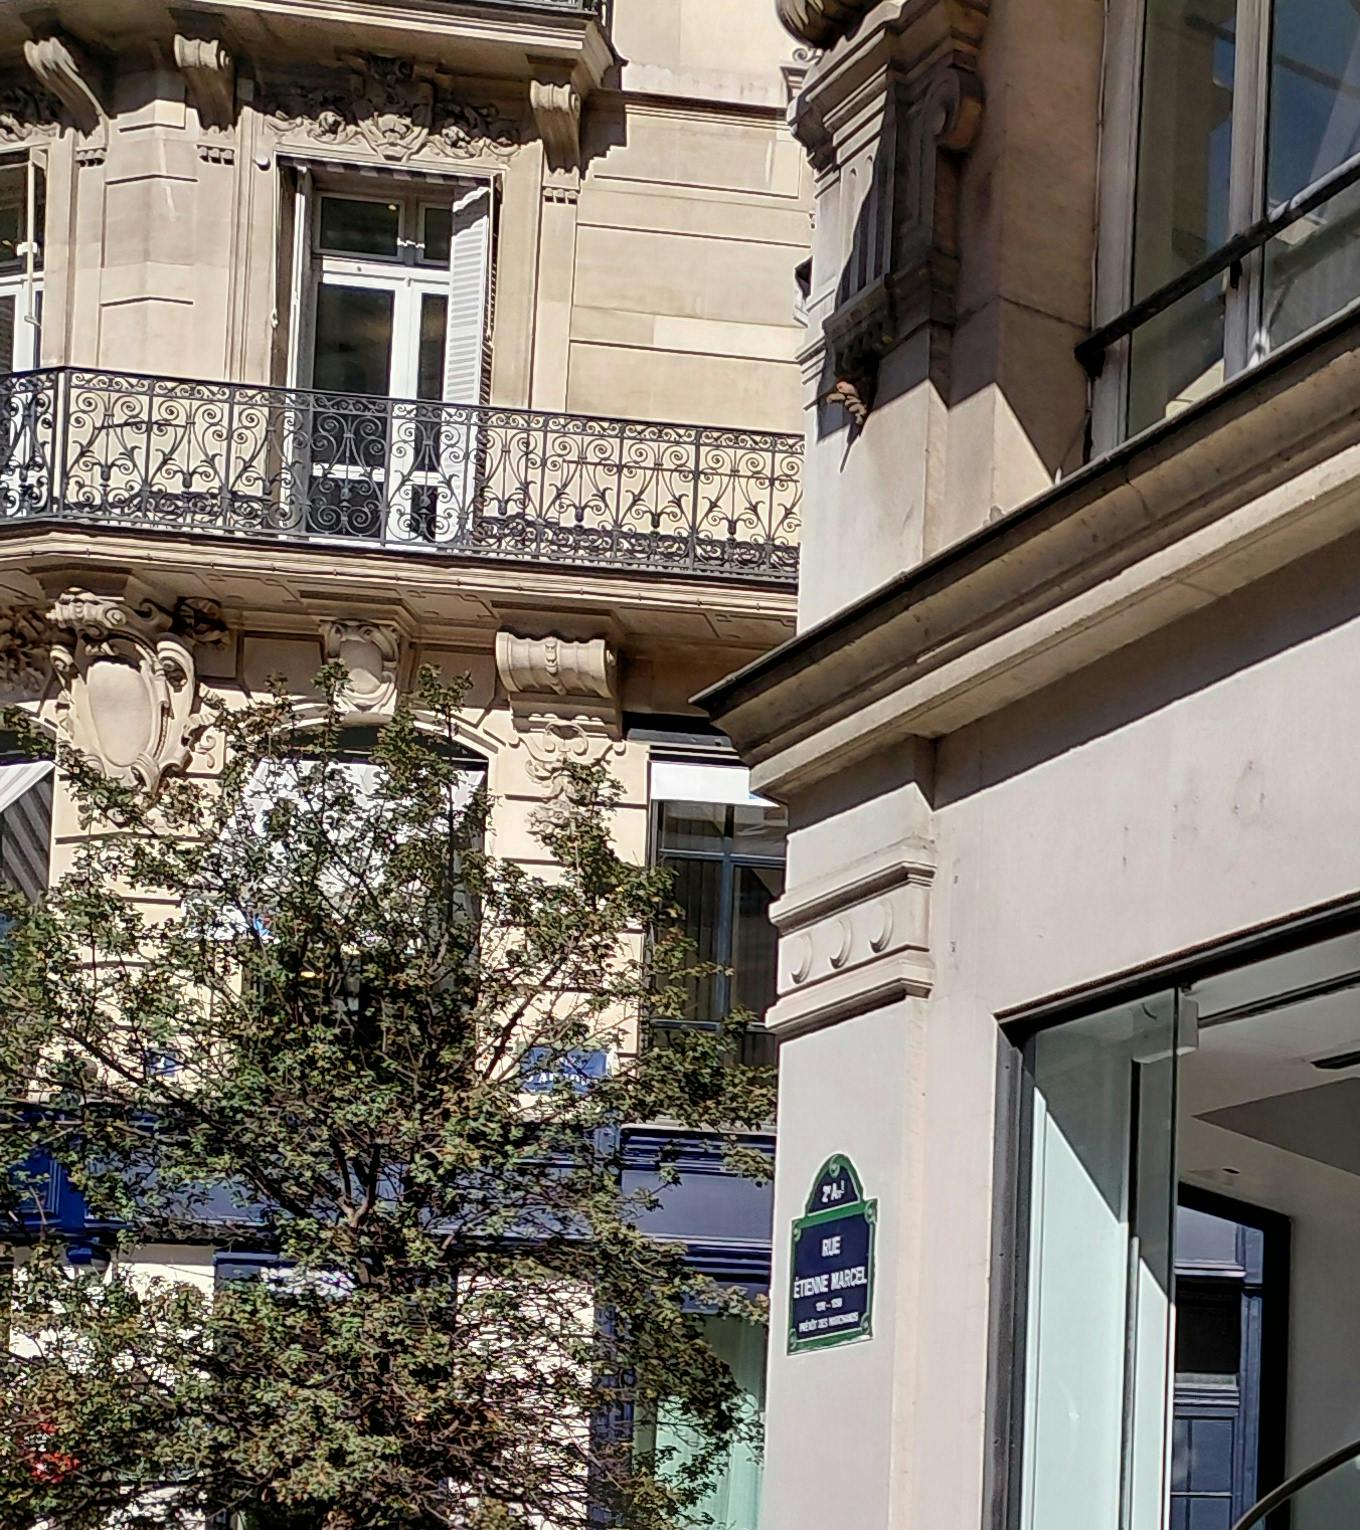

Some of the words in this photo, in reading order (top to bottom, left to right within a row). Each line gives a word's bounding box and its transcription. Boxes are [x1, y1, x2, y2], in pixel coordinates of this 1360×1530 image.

[822, 1235, 842, 1257] RUE
[793, 1275, 830, 1299] ÉTIENNE
[830, 1266, 868, 1291] MARCEL
